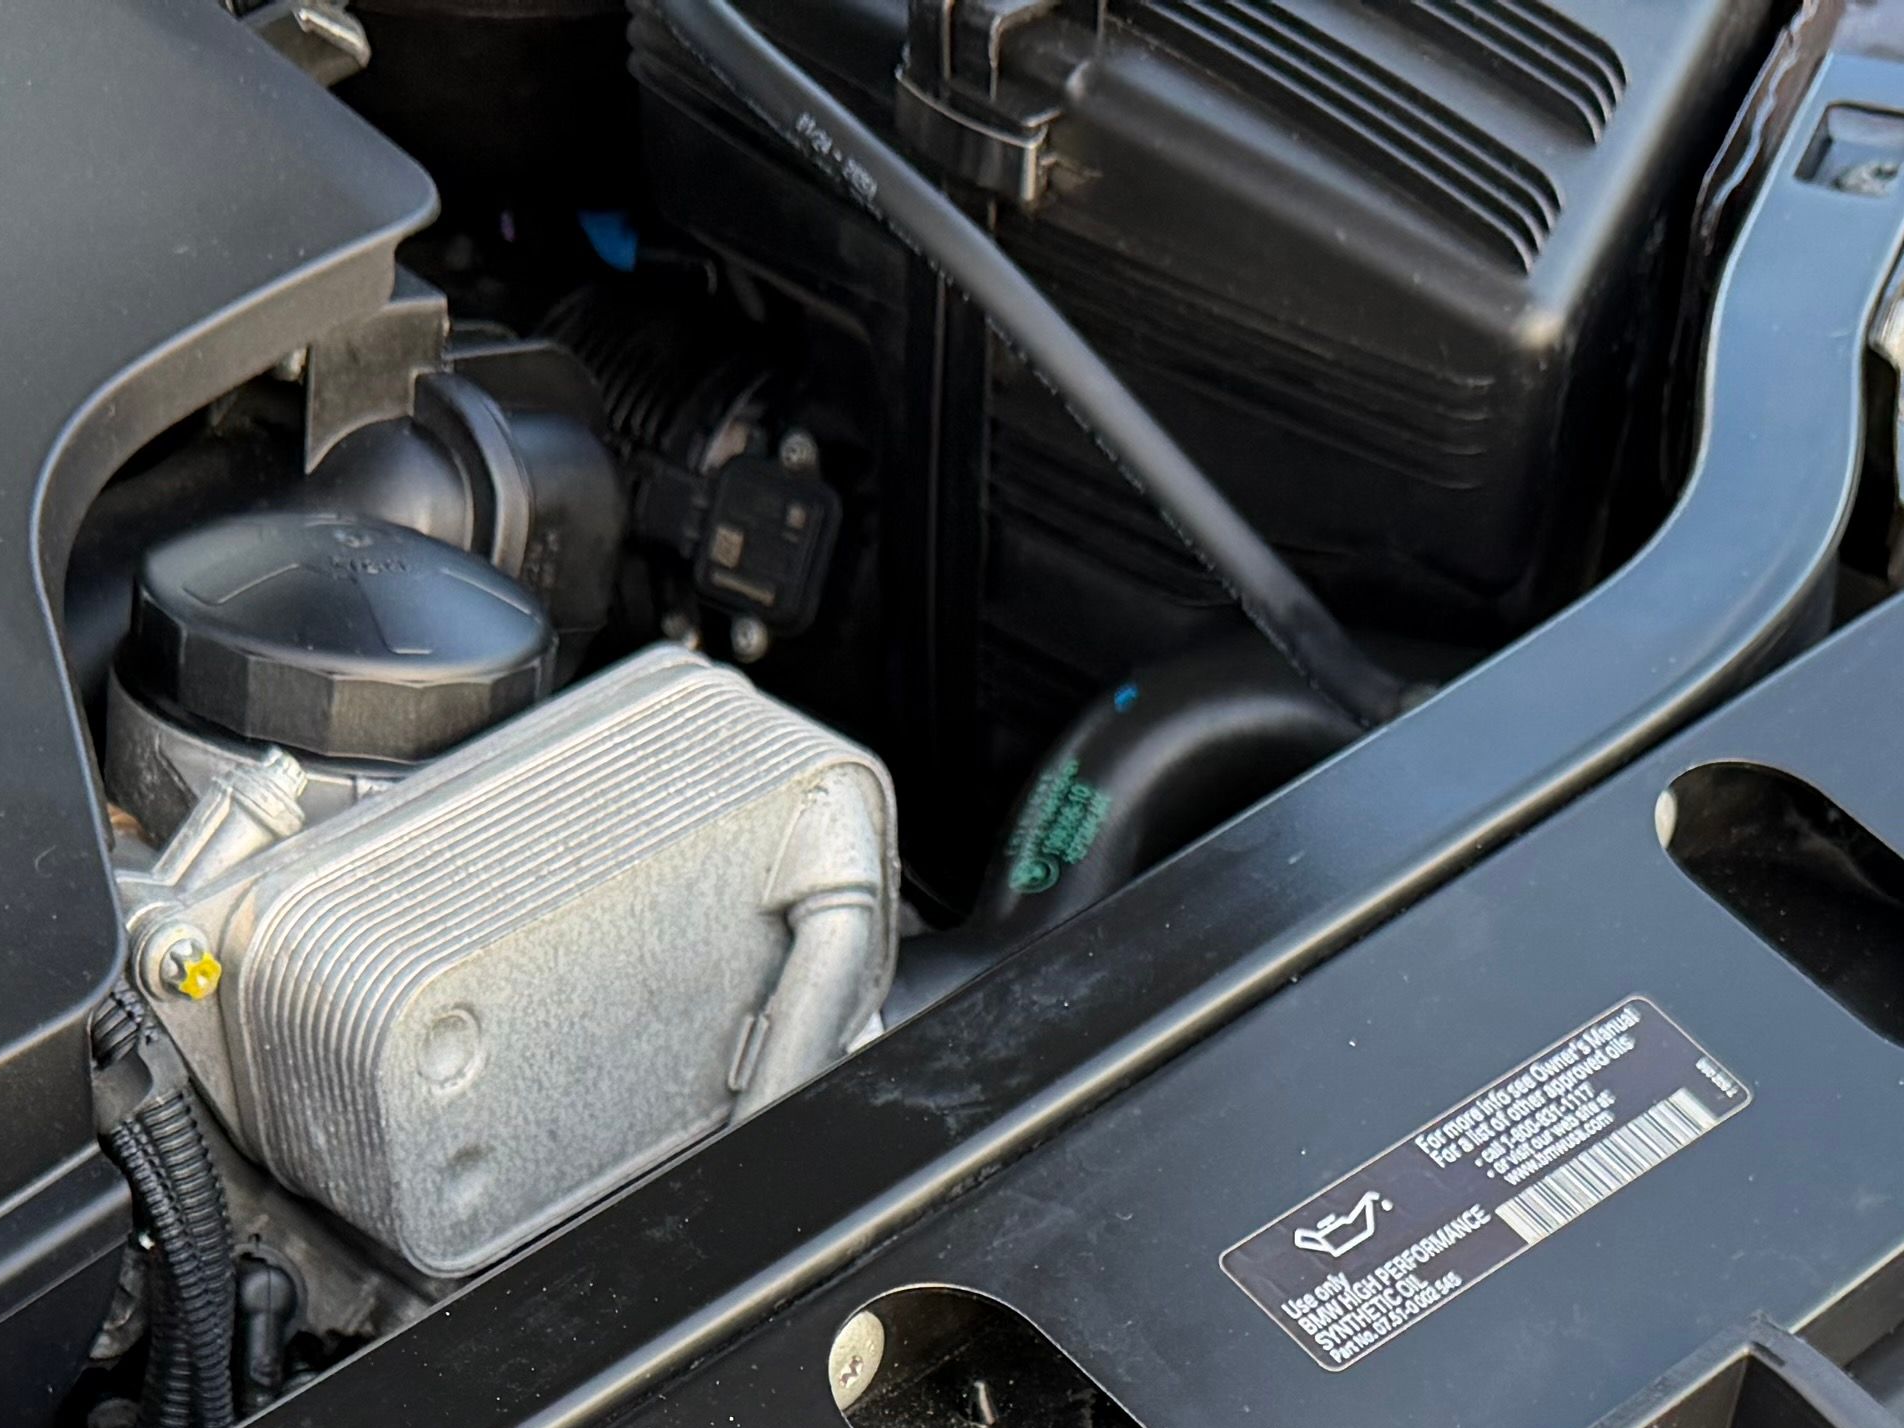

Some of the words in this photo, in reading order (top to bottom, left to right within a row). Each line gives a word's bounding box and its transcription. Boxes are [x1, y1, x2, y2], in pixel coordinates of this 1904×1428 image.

[1601, 1034, 1635, 1059] oils
[1415, 1129, 1451, 1154] For
[1442, 1106, 1484, 1139] more
[1476, 1089, 1511, 1115] info
[1507, 1073, 1537, 1100] see
[1530, 1038, 1596, 1082] Owner's
[1582, 1005, 1640, 1050] Manual
[1540, 1048, 1610, 1098] approved
[1481, 1140, 1506, 1163] call
[1500, 1081, 1595, 1151] 1-800-831-1117
[1490, 1109, 1511, 1131] of
[1501, 1089, 1546, 1121] other
[1458, 1136, 1474, 1152] a
[1465, 1120, 1496, 1146] list
[1493, 1158, 1510, 1174] or
[1531, 1130, 1553, 1149] our
[1546, 1113, 1580, 1137] web
[1428, 1143, 1462, 1168] For
[1298, 1299, 1344, 1335] BMW
[1337, 1274, 1383, 1310] HIGH
[1374, 1204, 1491, 1285] PERFORMANCE
[1281, 1294, 1318, 1319] Use
[1314, 1272, 1356, 1305] only
[1315, 1288, 1402, 1350] SYNTHETIC
[1395, 1274, 1429, 1298] OIL
[1330, 1341, 1360, 1363] Part
[1353, 1330, 1379, 1348] No.
